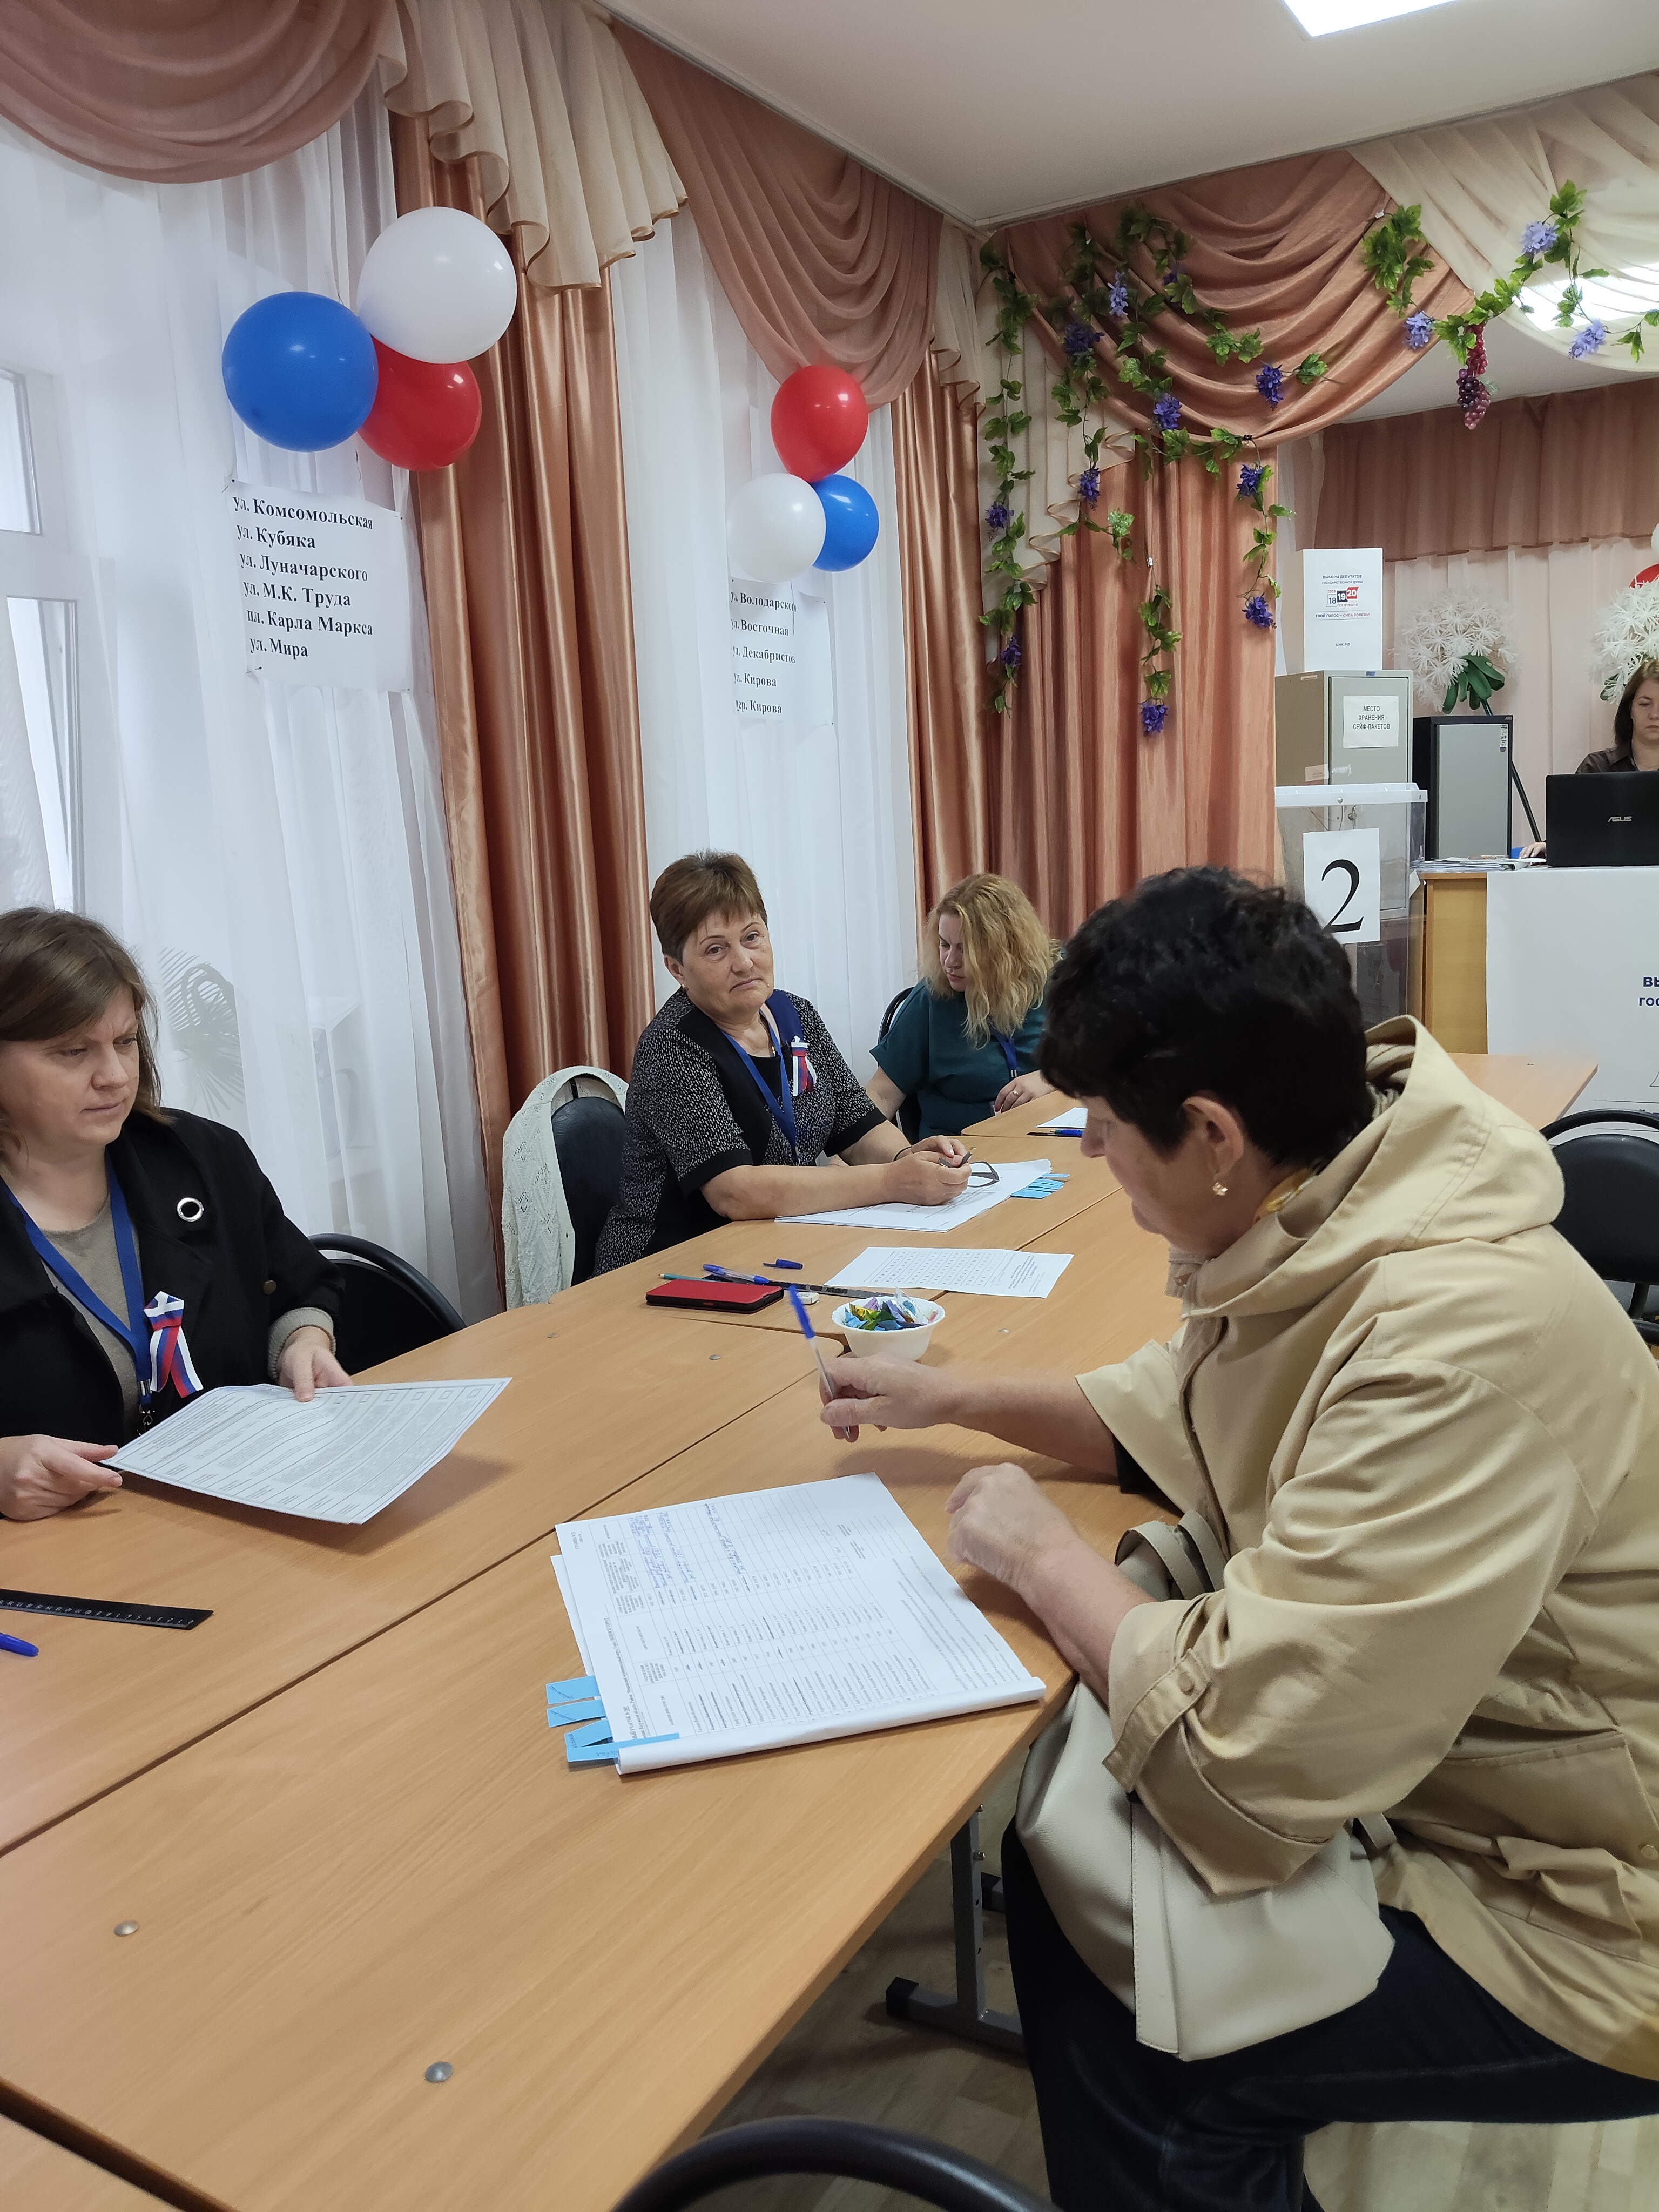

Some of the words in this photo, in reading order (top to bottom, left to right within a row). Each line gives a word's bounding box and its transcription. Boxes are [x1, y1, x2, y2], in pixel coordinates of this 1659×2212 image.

[232, 496, 249, 512] ул.
[253, 498, 373, 530] Комсомольская
[237, 524, 253, 540] ул.
[255, 526, 316, 549] Кубяка
[239, 553, 256, 569] ул.
[260, 555, 368, 581] Луначарского
[243, 582, 259, 597] ул.
[262, 583, 297, 602] М.К.
[302, 588, 351, 609] Труда
[740, 592, 797, 612] Володарского
[247, 609, 264, 624] пл.
[267, 610, 313, 632] Карла
[318, 616, 373, 637] Маркса
[741, 619, 788, 636] Восточная
[249, 638, 267, 653] ул.
[269, 638, 309, 660] Мира
[743, 646, 795, 664] Декабристов
[744, 673, 777, 688] Кирова
[750, 700, 782, 714] Кирова
[1321, 859, 1364, 933] 2
